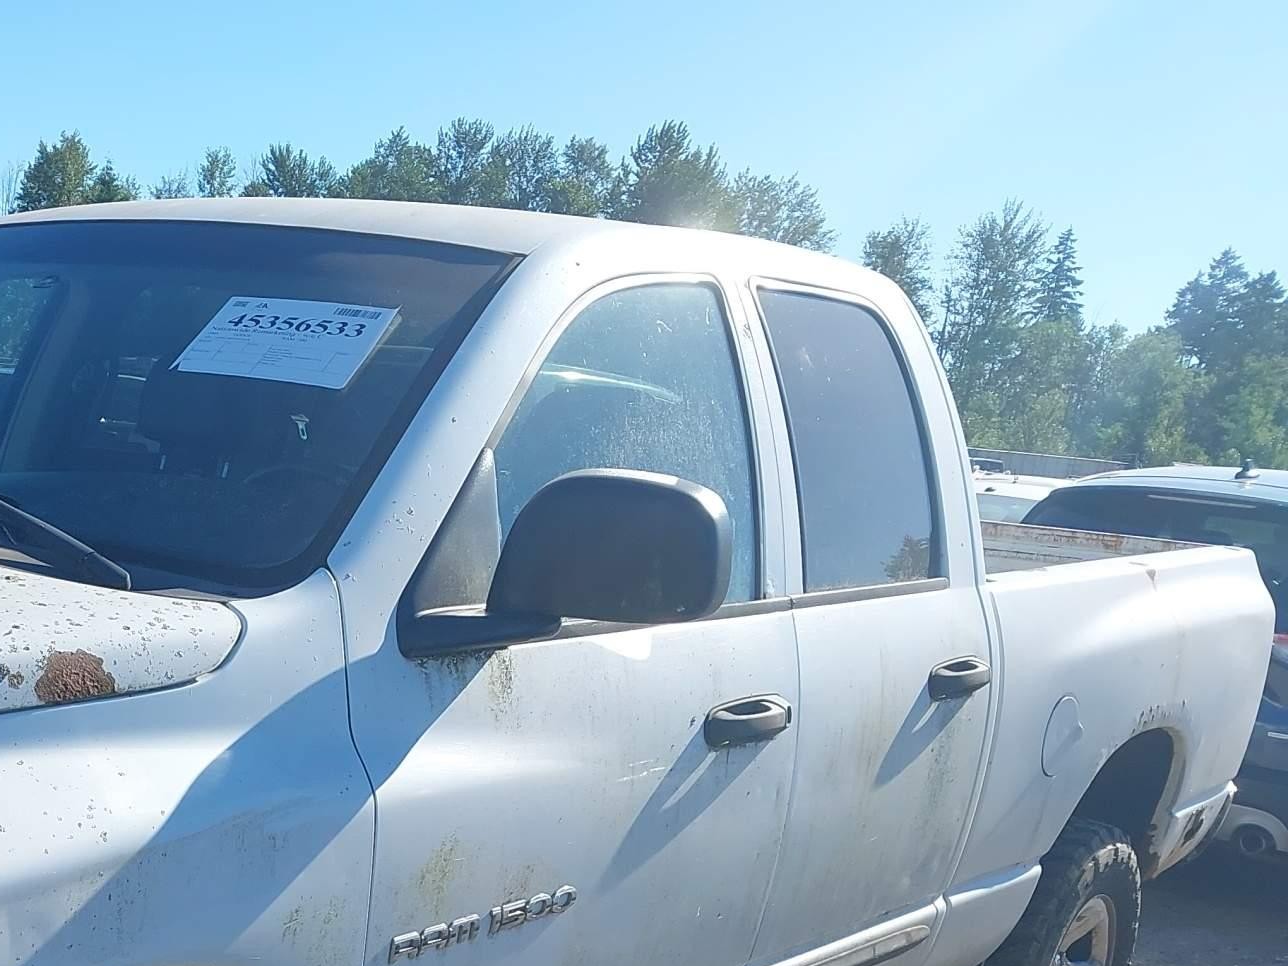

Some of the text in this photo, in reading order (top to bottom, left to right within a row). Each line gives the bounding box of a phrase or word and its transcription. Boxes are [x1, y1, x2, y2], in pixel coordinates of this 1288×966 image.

[227, 313, 367, 338] 45356533
[388, 885, 577, 965] RAM 1500
